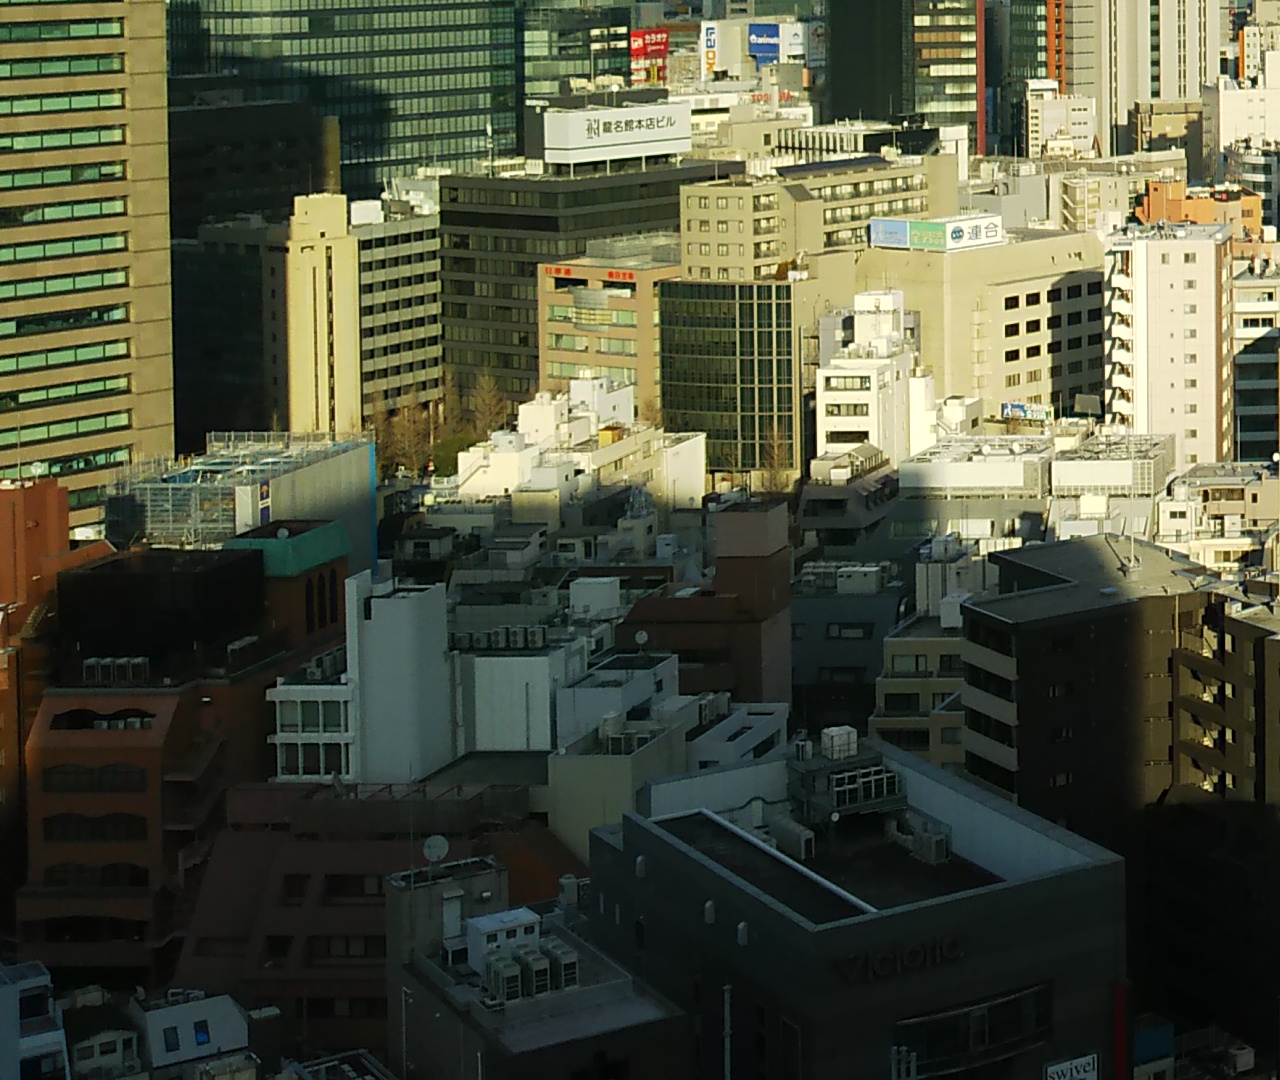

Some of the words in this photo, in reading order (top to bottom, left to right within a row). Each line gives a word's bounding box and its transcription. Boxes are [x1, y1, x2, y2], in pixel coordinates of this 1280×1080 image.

[602, 116, 676, 134] 龍名館本店ビル
[967, 222, 999, 241] 連合
